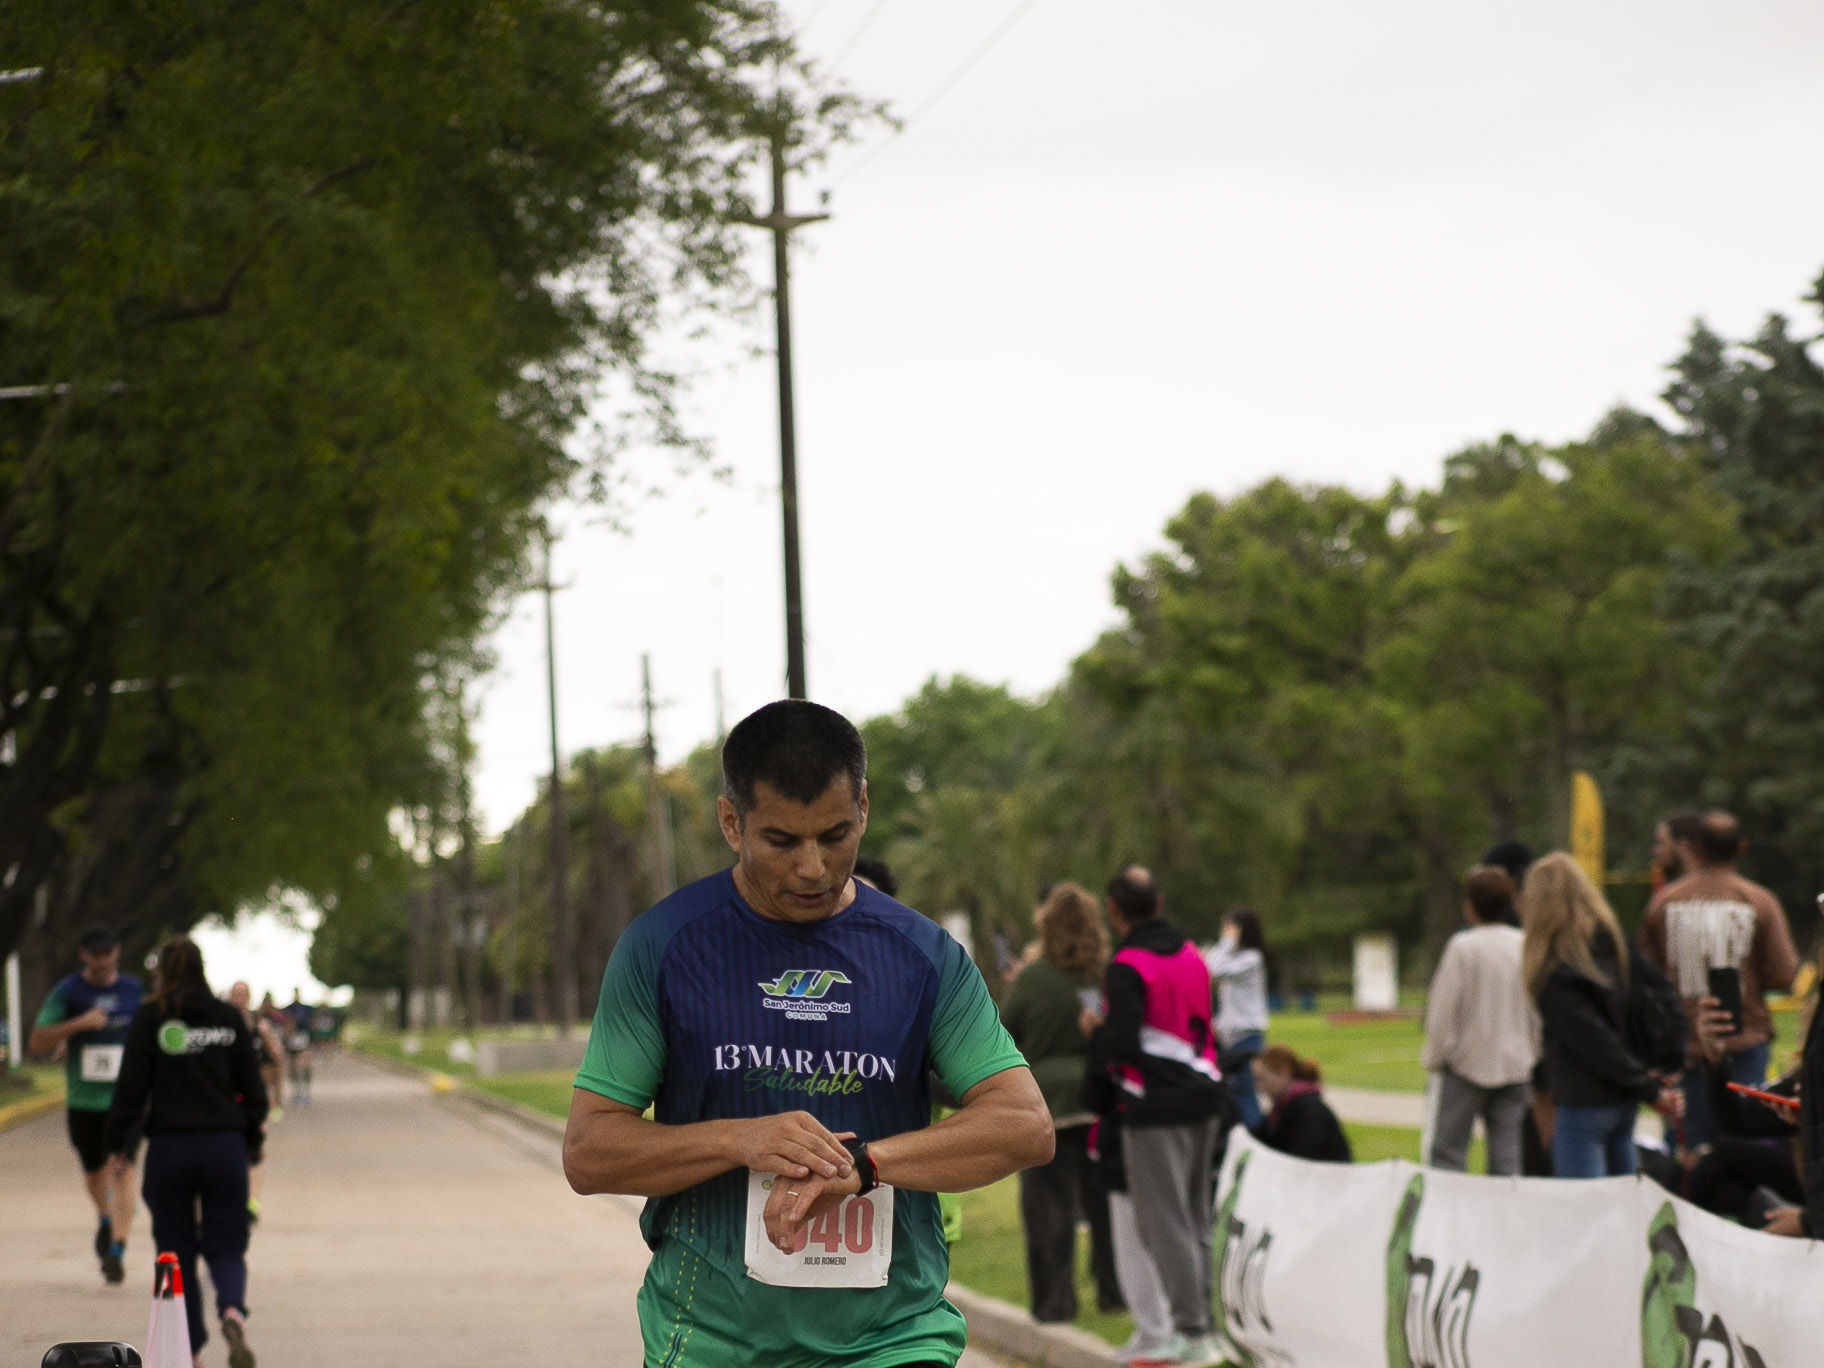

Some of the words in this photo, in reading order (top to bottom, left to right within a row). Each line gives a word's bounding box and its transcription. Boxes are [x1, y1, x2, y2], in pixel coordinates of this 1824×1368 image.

[763, 998, 782, 1009] San
[783, 1000, 829, 1012] Jerónimo
[831, 1002, 849, 1013] Sud
[786, 1012, 827, 1020] COMUNA
[748, 1045, 896, 1083] MARATON
[743, 1065, 864, 1097] Saludable
[803, 1256, 820, 1266] JULIO
[821, 1256, 847, 1266] ROMERO
